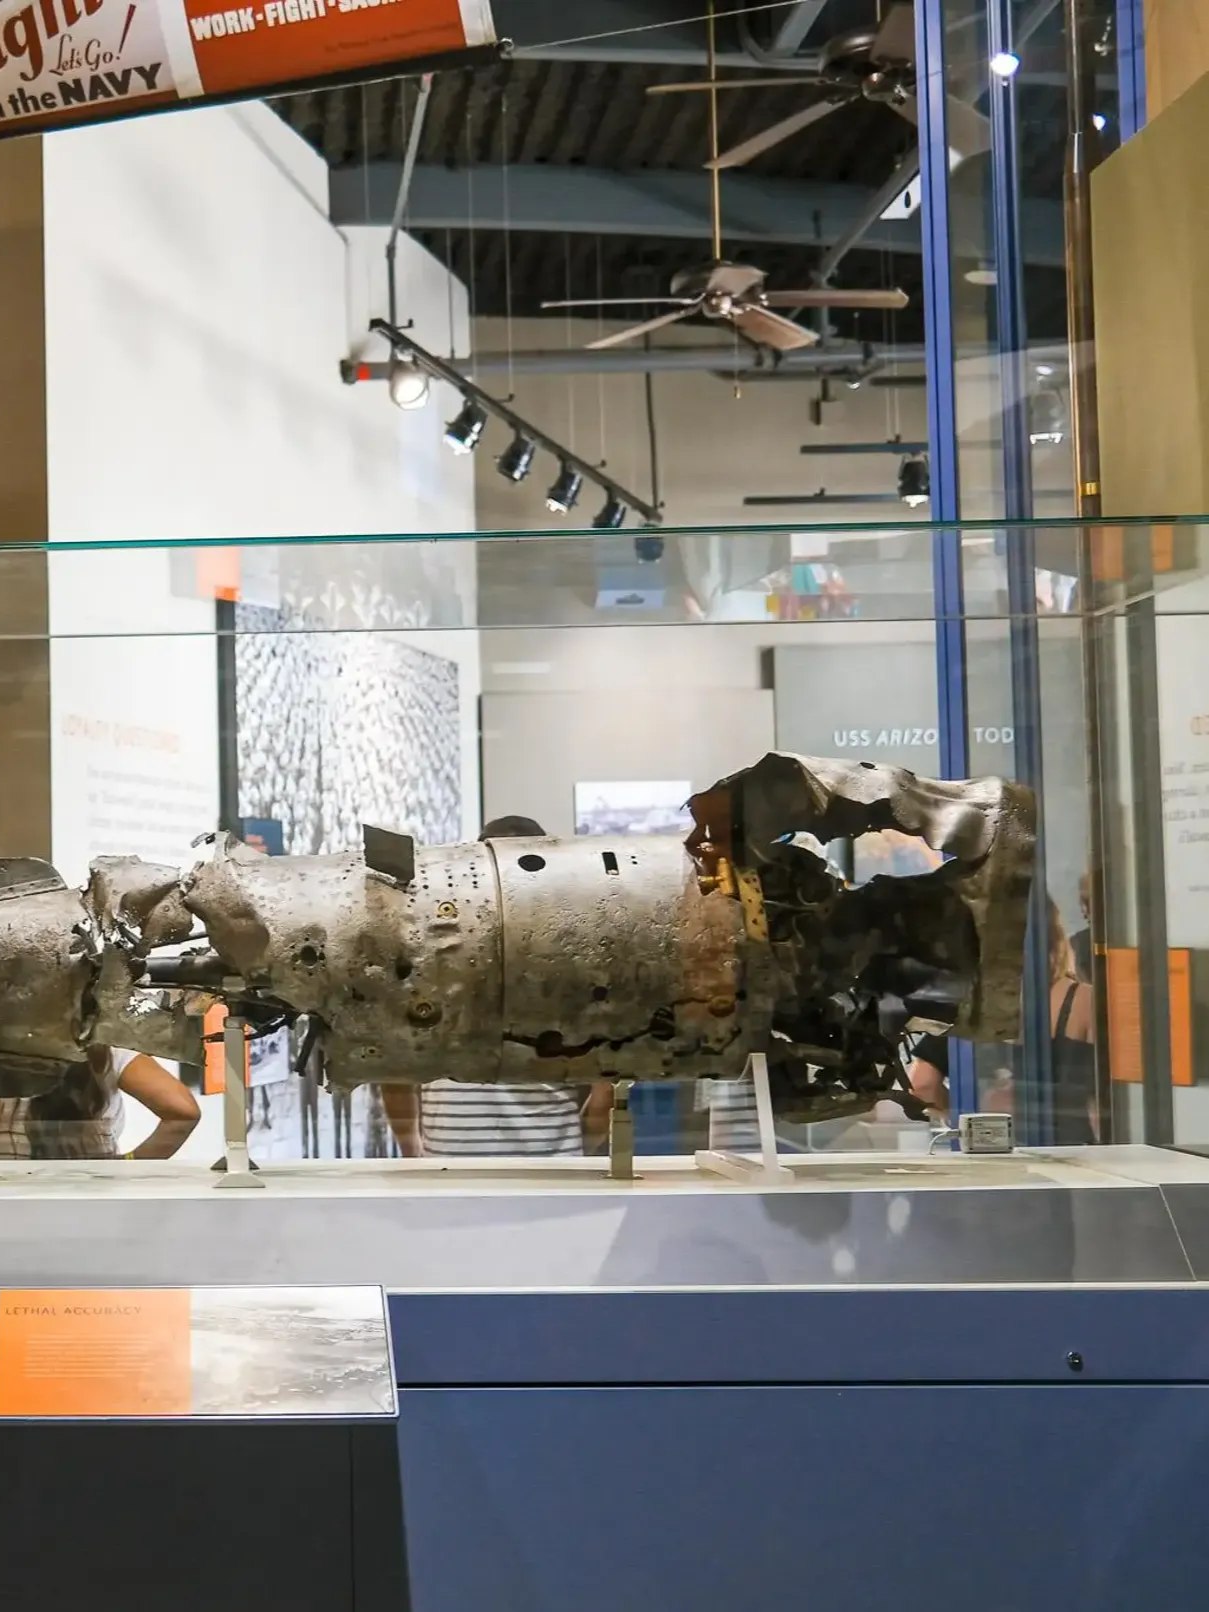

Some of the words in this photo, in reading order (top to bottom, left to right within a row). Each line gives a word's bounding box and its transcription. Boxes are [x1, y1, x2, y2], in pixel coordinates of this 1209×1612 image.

[8, 87, 57, 115] the
[57, 62, 163, 106] NAVY
[834, 729, 871, 747] USS
[875, 728, 937, 747] ARIZO
[973, 727, 1014, 744] TOD
[5, 1306, 58, 1316] LETHAL
[63, 1305, 143, 1316] ACCURACY
